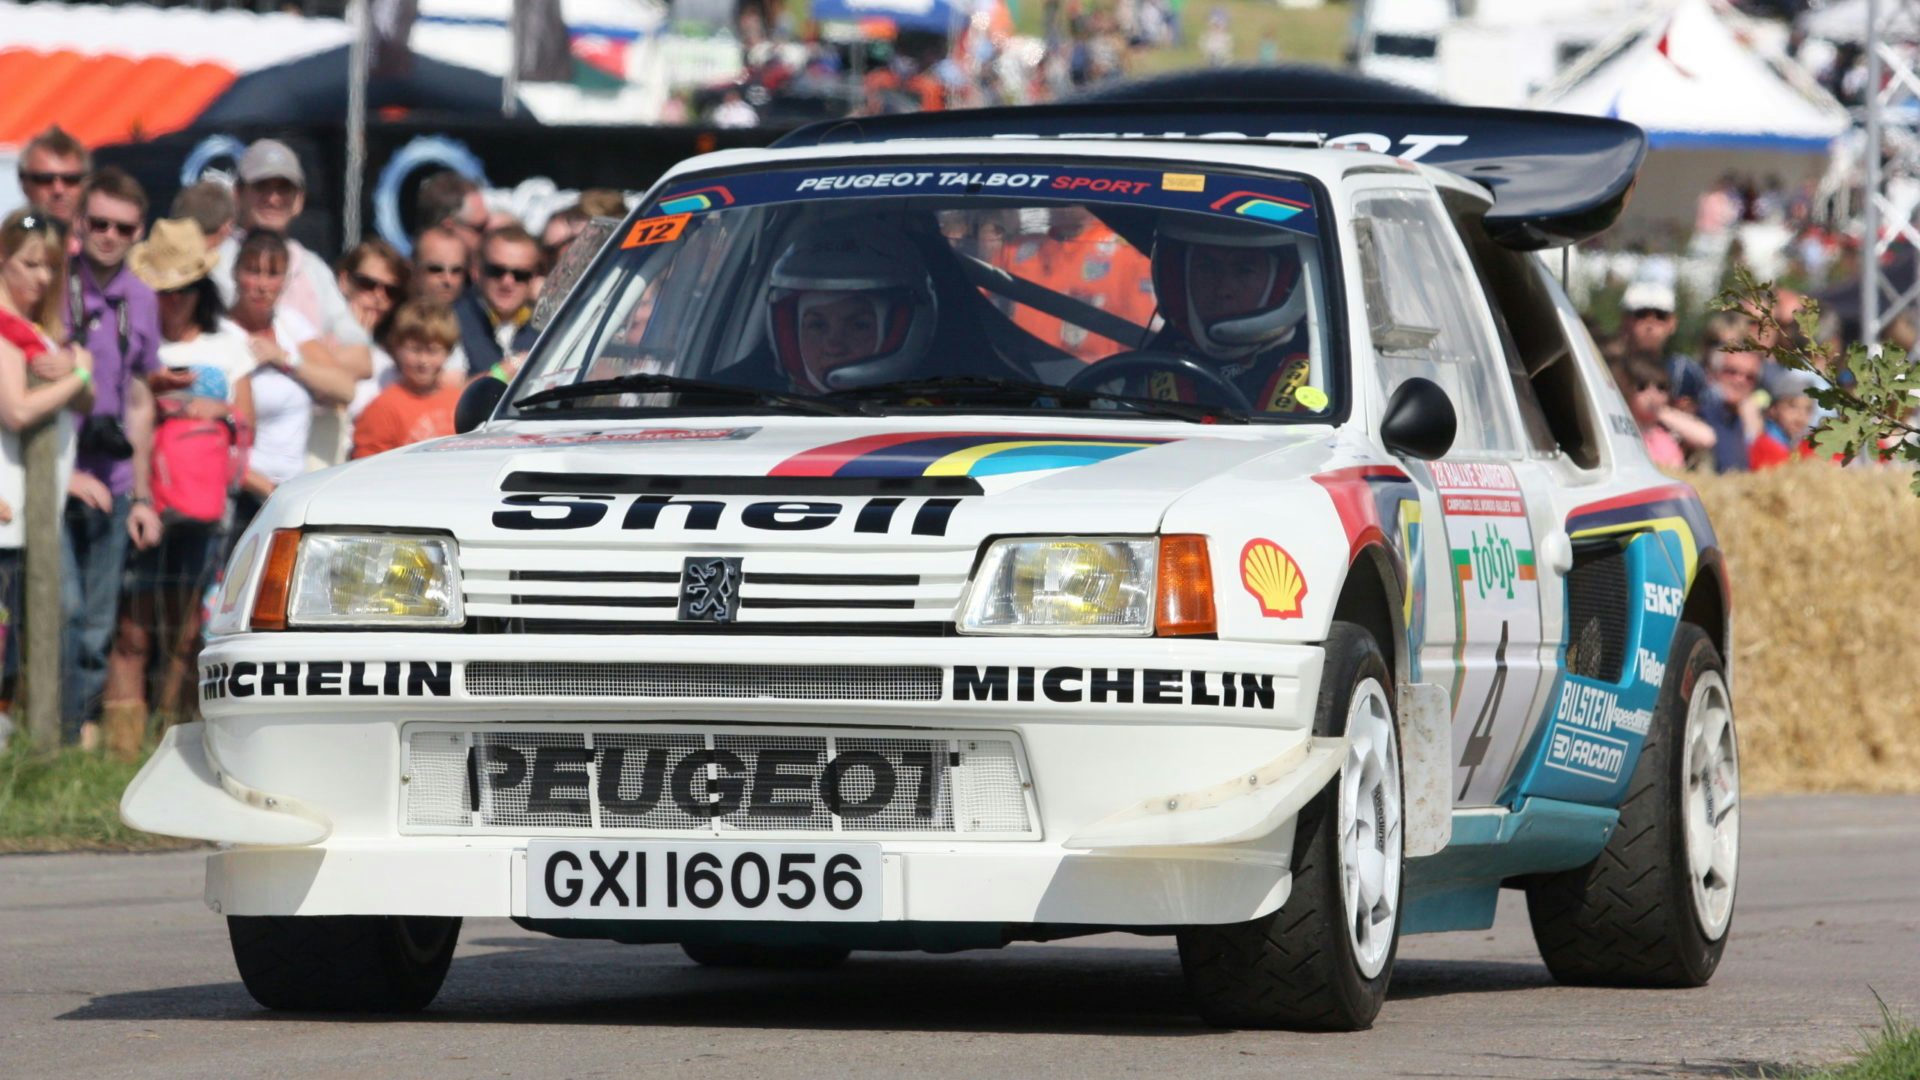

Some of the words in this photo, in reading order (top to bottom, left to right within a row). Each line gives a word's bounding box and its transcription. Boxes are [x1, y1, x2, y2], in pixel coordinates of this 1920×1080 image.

[796, 172, 934, 192] PEUGEOT
[937, 172, 1049, 189] TALBOT
[1051, 175, 1151, 195] SPORT
[637, 222, 676, 243] 12
[491, 489, 965, 536] Shell
[1471, 522, 1516, 600] totip
[203, 661, 452, 700] MICHELIN
[952, 665, 1275, 709] MICHELIN
[1457, 620, 1509, 801] 4
[1557, 681, 1618, 732] BILSTEIN
[1570, 739, 1623, 773] FACOM
[467, 745, 959, 818] PEUGEOT
